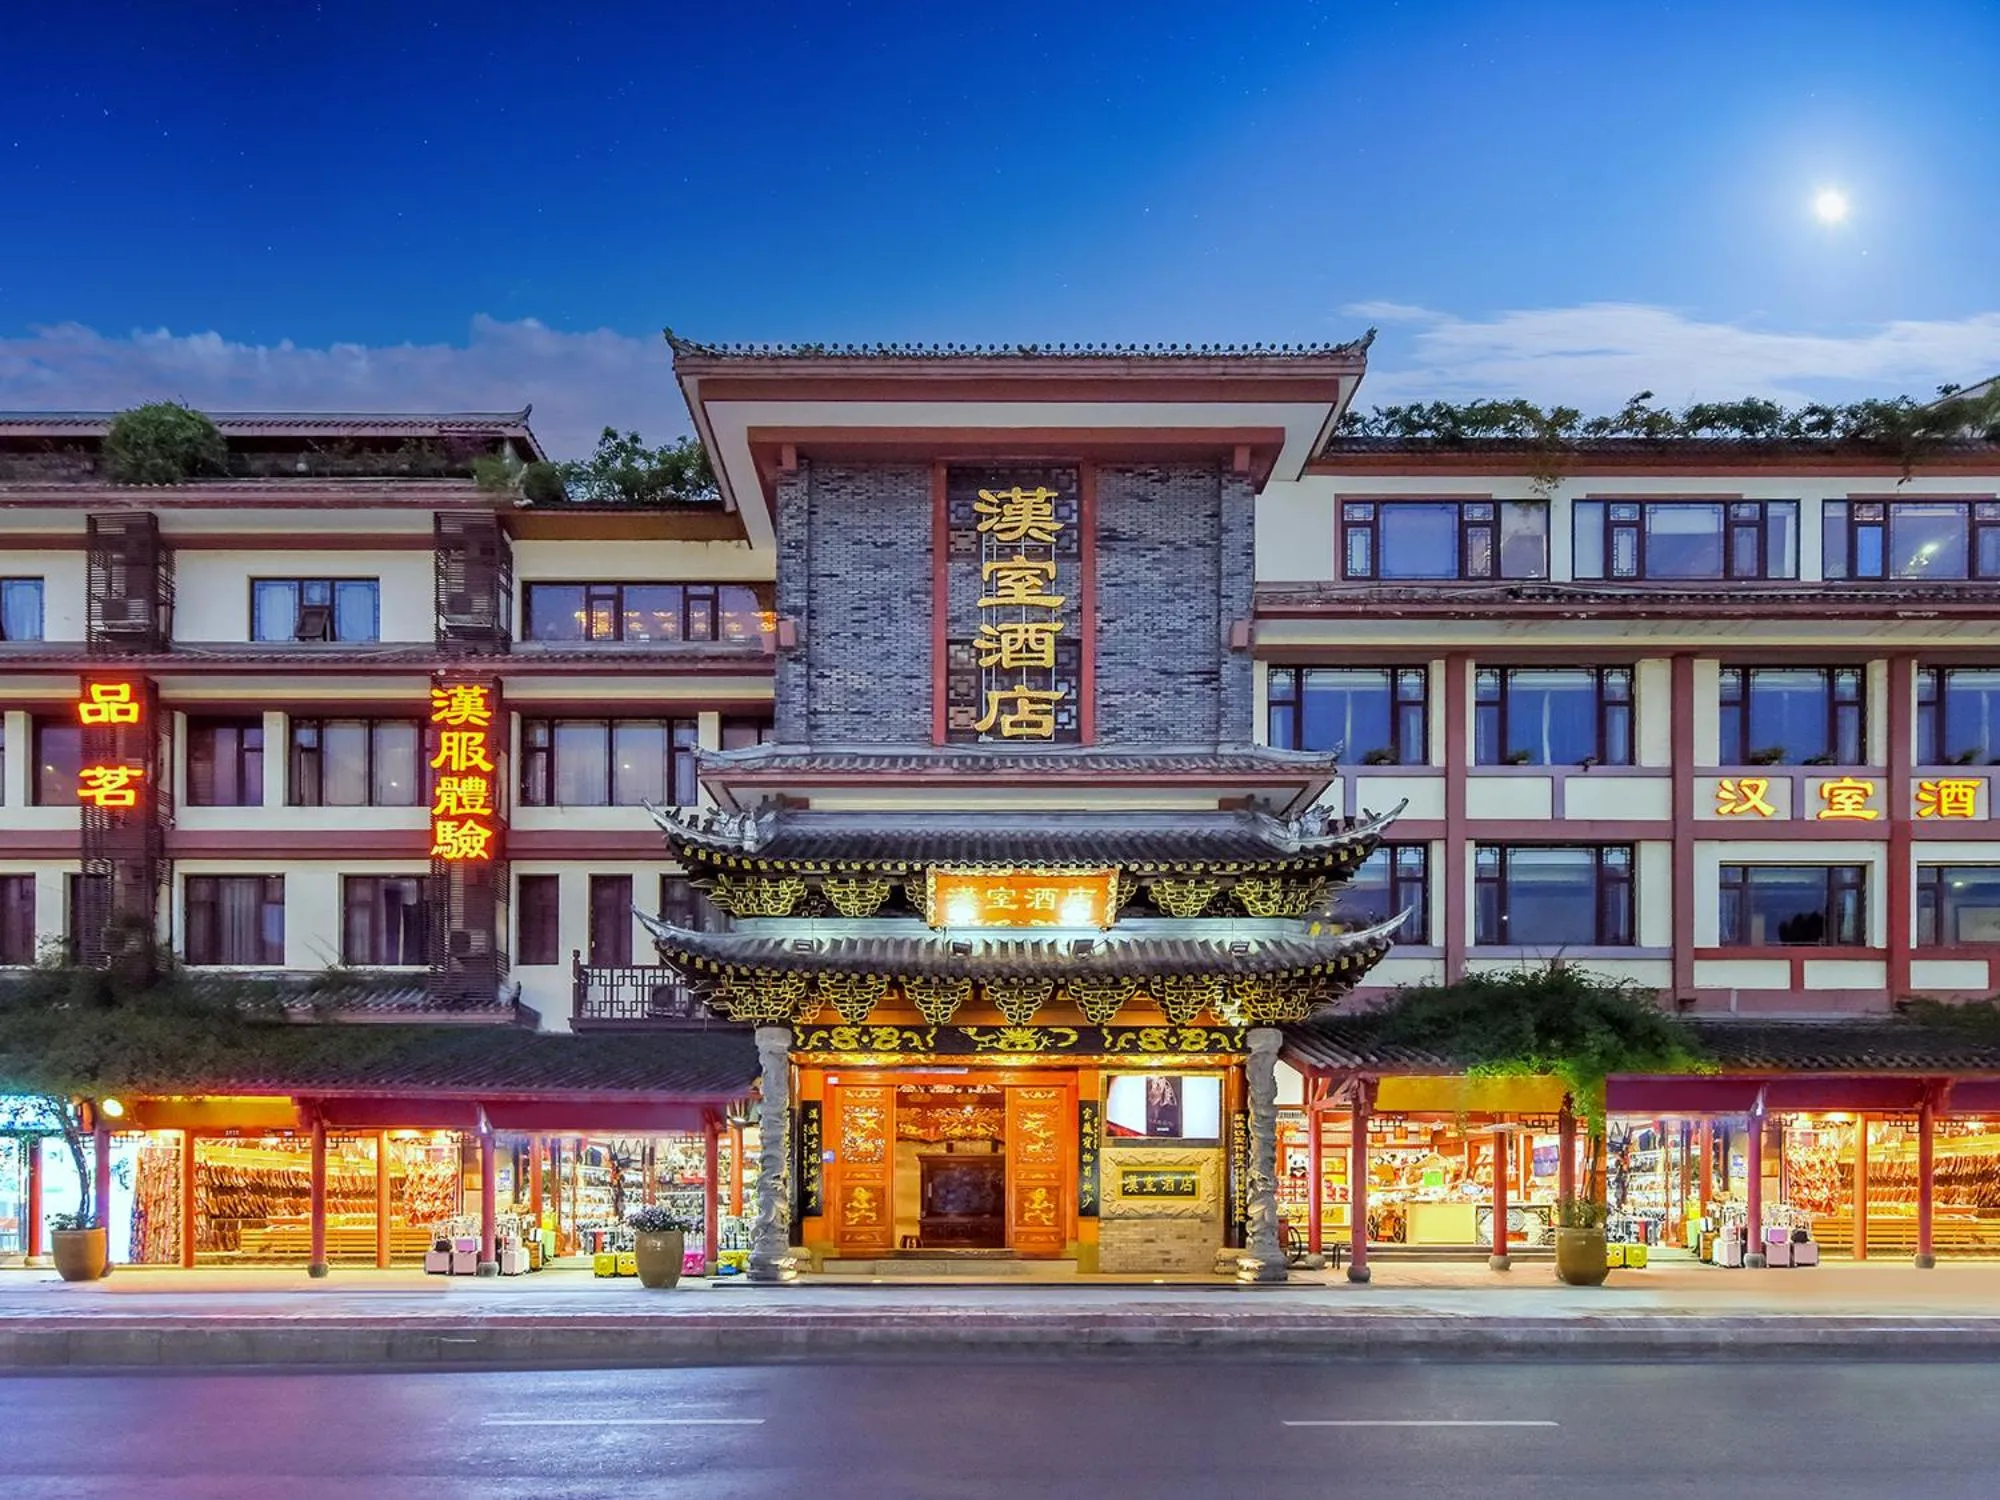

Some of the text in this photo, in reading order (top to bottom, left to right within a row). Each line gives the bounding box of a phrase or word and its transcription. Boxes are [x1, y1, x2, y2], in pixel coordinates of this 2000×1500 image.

[973, 486, 1065, 737] 漢室酒店
[77, 682, 144, 807] 品茗
[430, 684, 495, 860] 漢服體驗
[1716, 777, 1981, 820] 汉室酒
